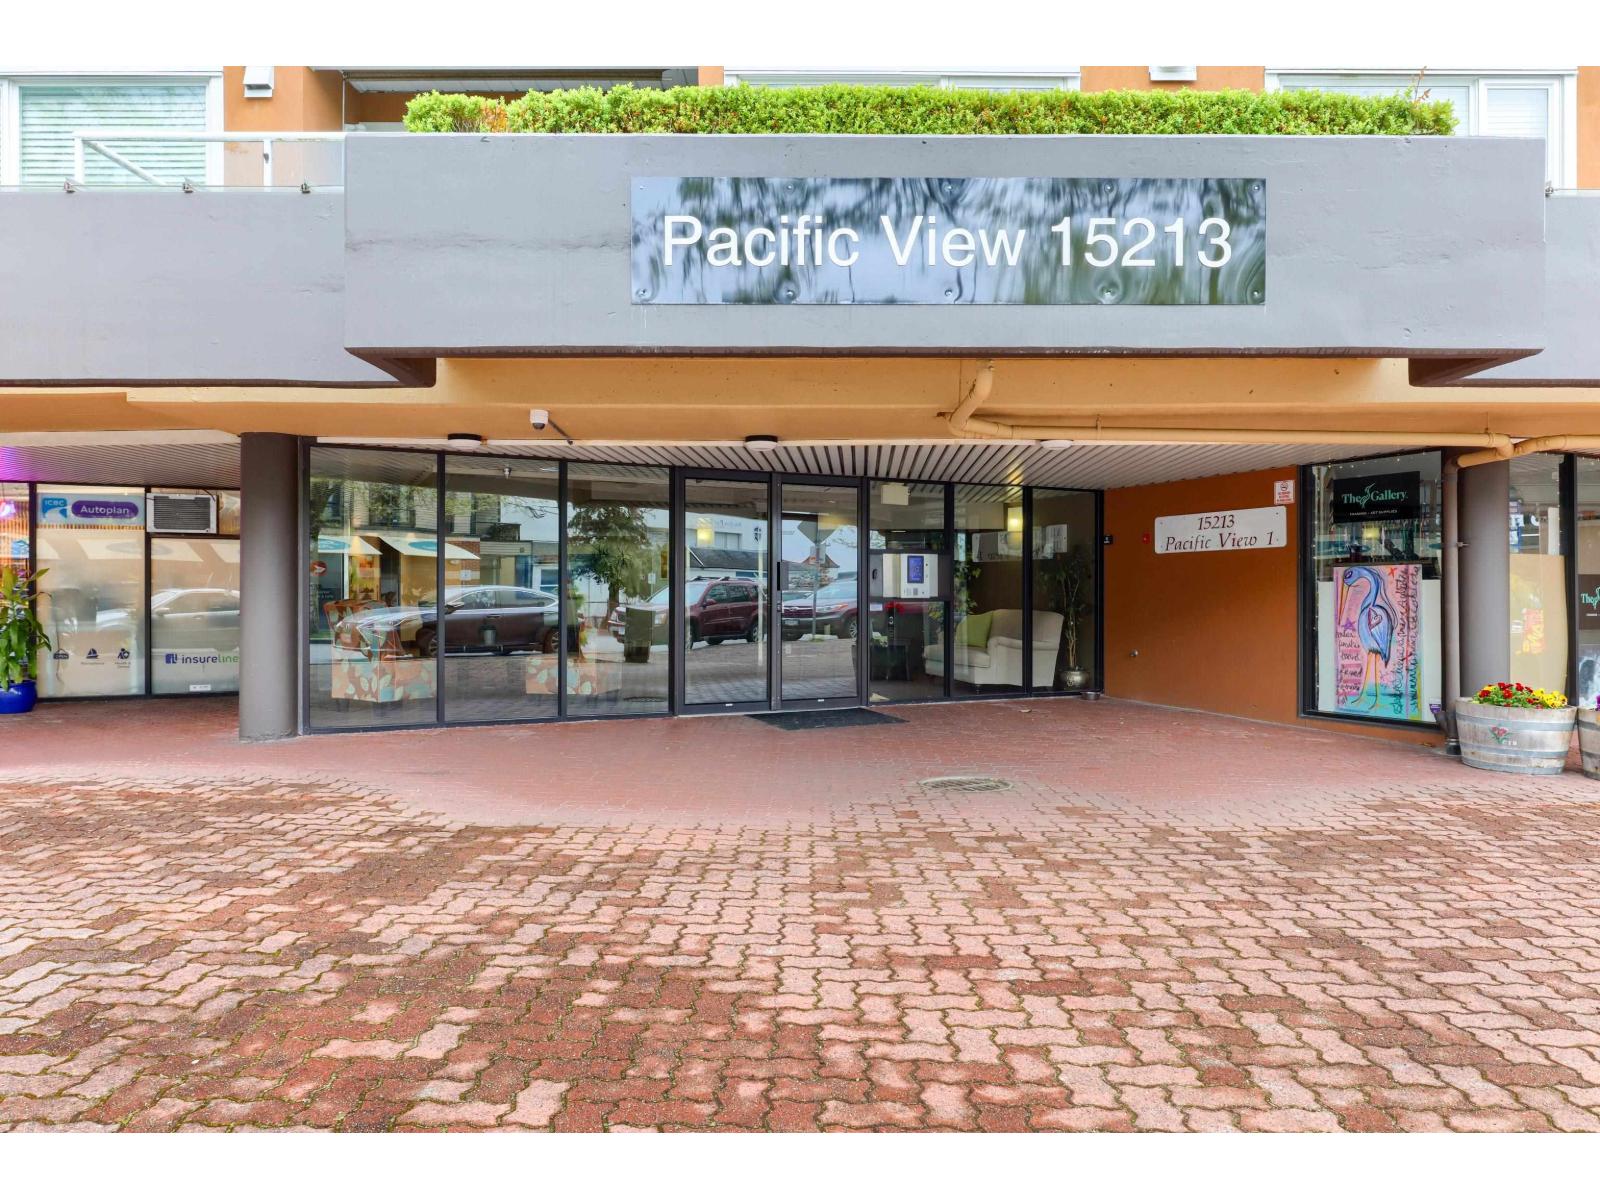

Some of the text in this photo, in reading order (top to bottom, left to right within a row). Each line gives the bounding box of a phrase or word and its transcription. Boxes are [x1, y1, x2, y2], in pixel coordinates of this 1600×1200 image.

[663, 214, 1233, 268] Pacific View 15213
[1341, 489, 1407, 504] The Gallery
[80, 505, 130, 515] Autoplan
[1198, 514, 1235, 530] 15213
[1165, 531, 1274, 552] Pacific View 1
[181, 654, 239, 664] insureline
